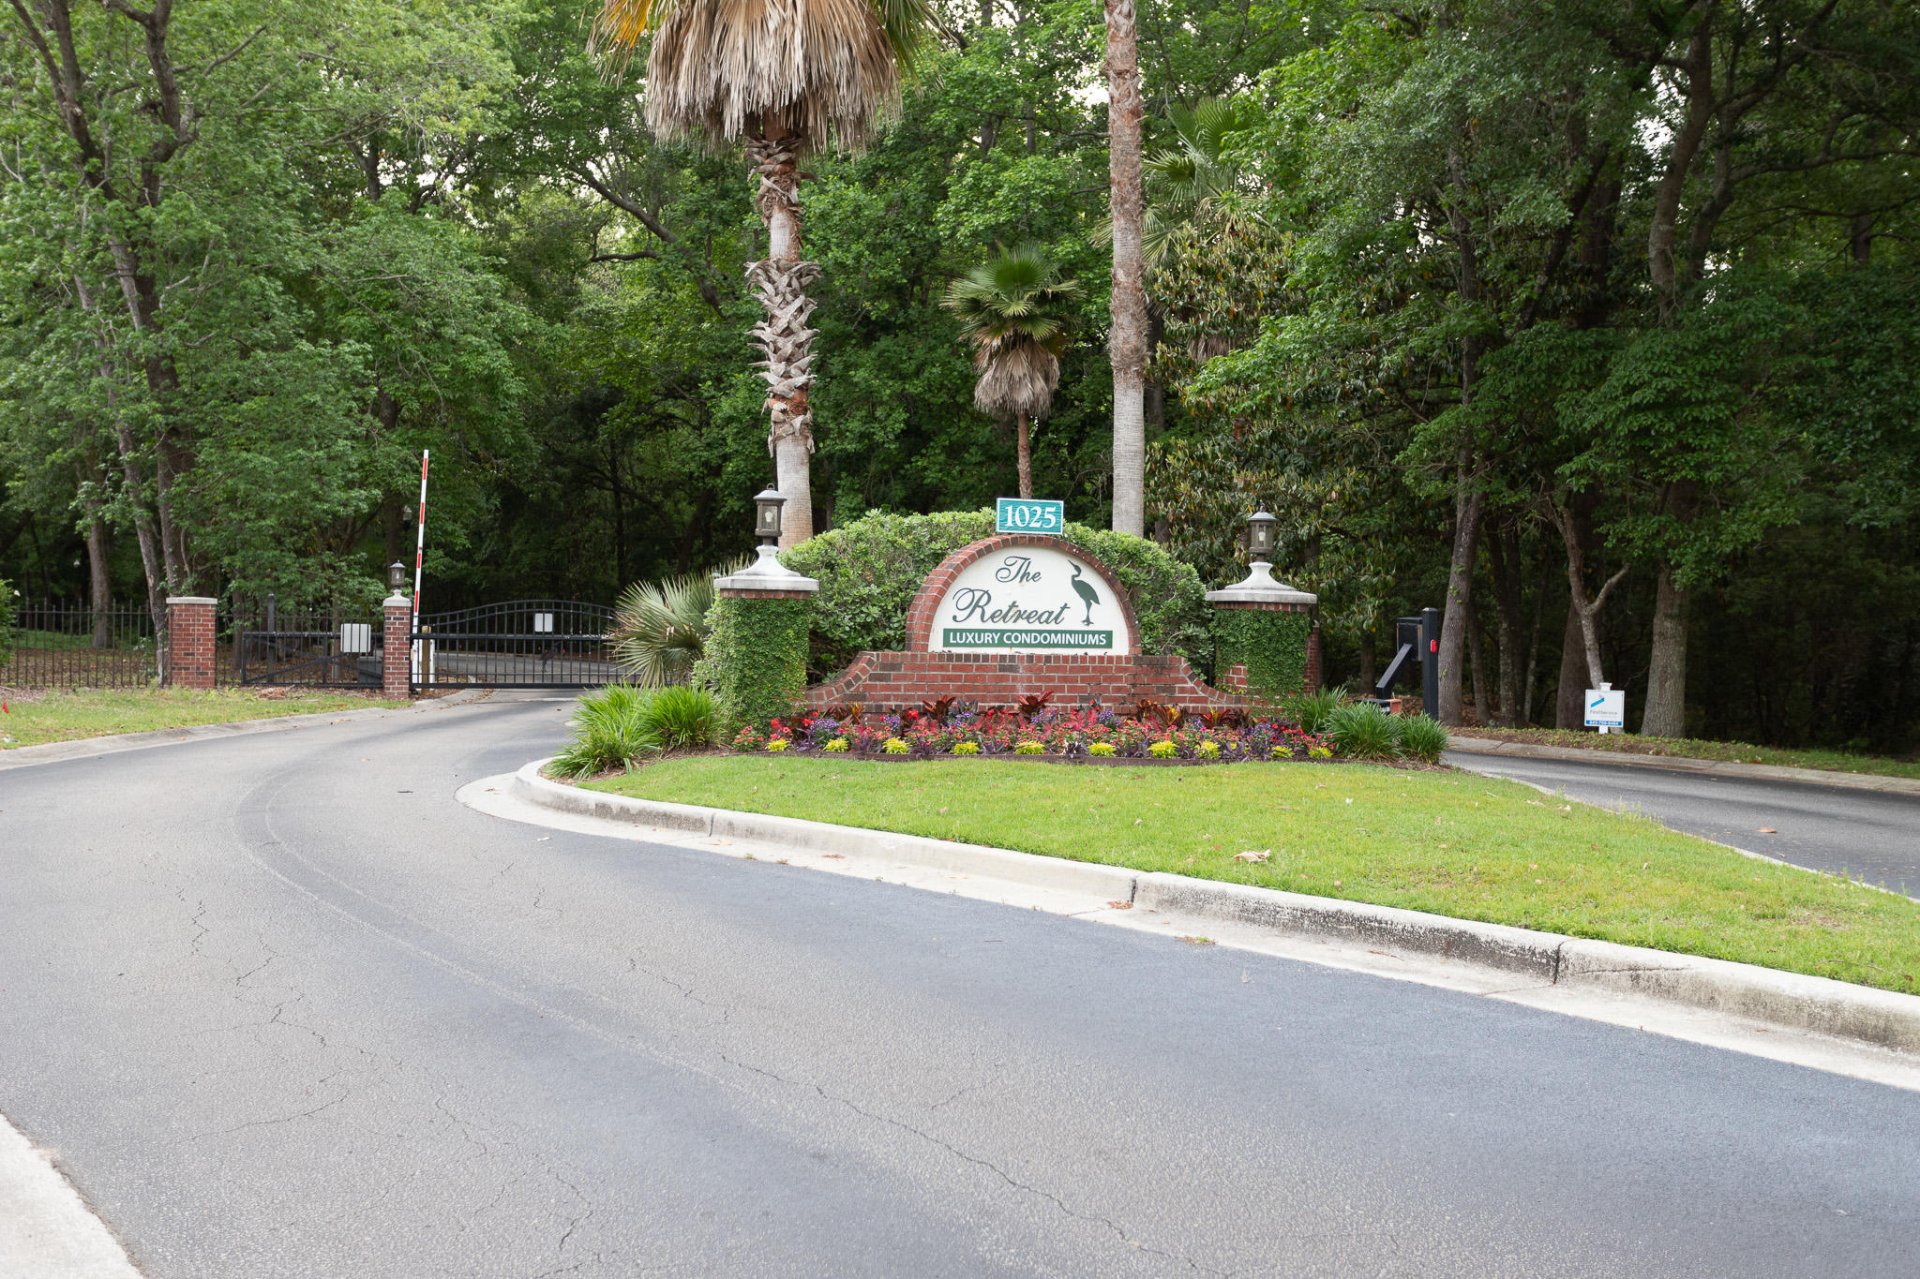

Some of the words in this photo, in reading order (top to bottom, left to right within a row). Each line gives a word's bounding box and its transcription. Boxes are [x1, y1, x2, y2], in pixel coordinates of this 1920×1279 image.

[1004, 505, 1057, 528] 1025
[995, 555, 1042, 583] The
[952, 587, 1071, 625] Retreat
[949, 632, 1000, 644] LUXURY
[1003, 632, 1107, 645] CONDOMINIUMS
